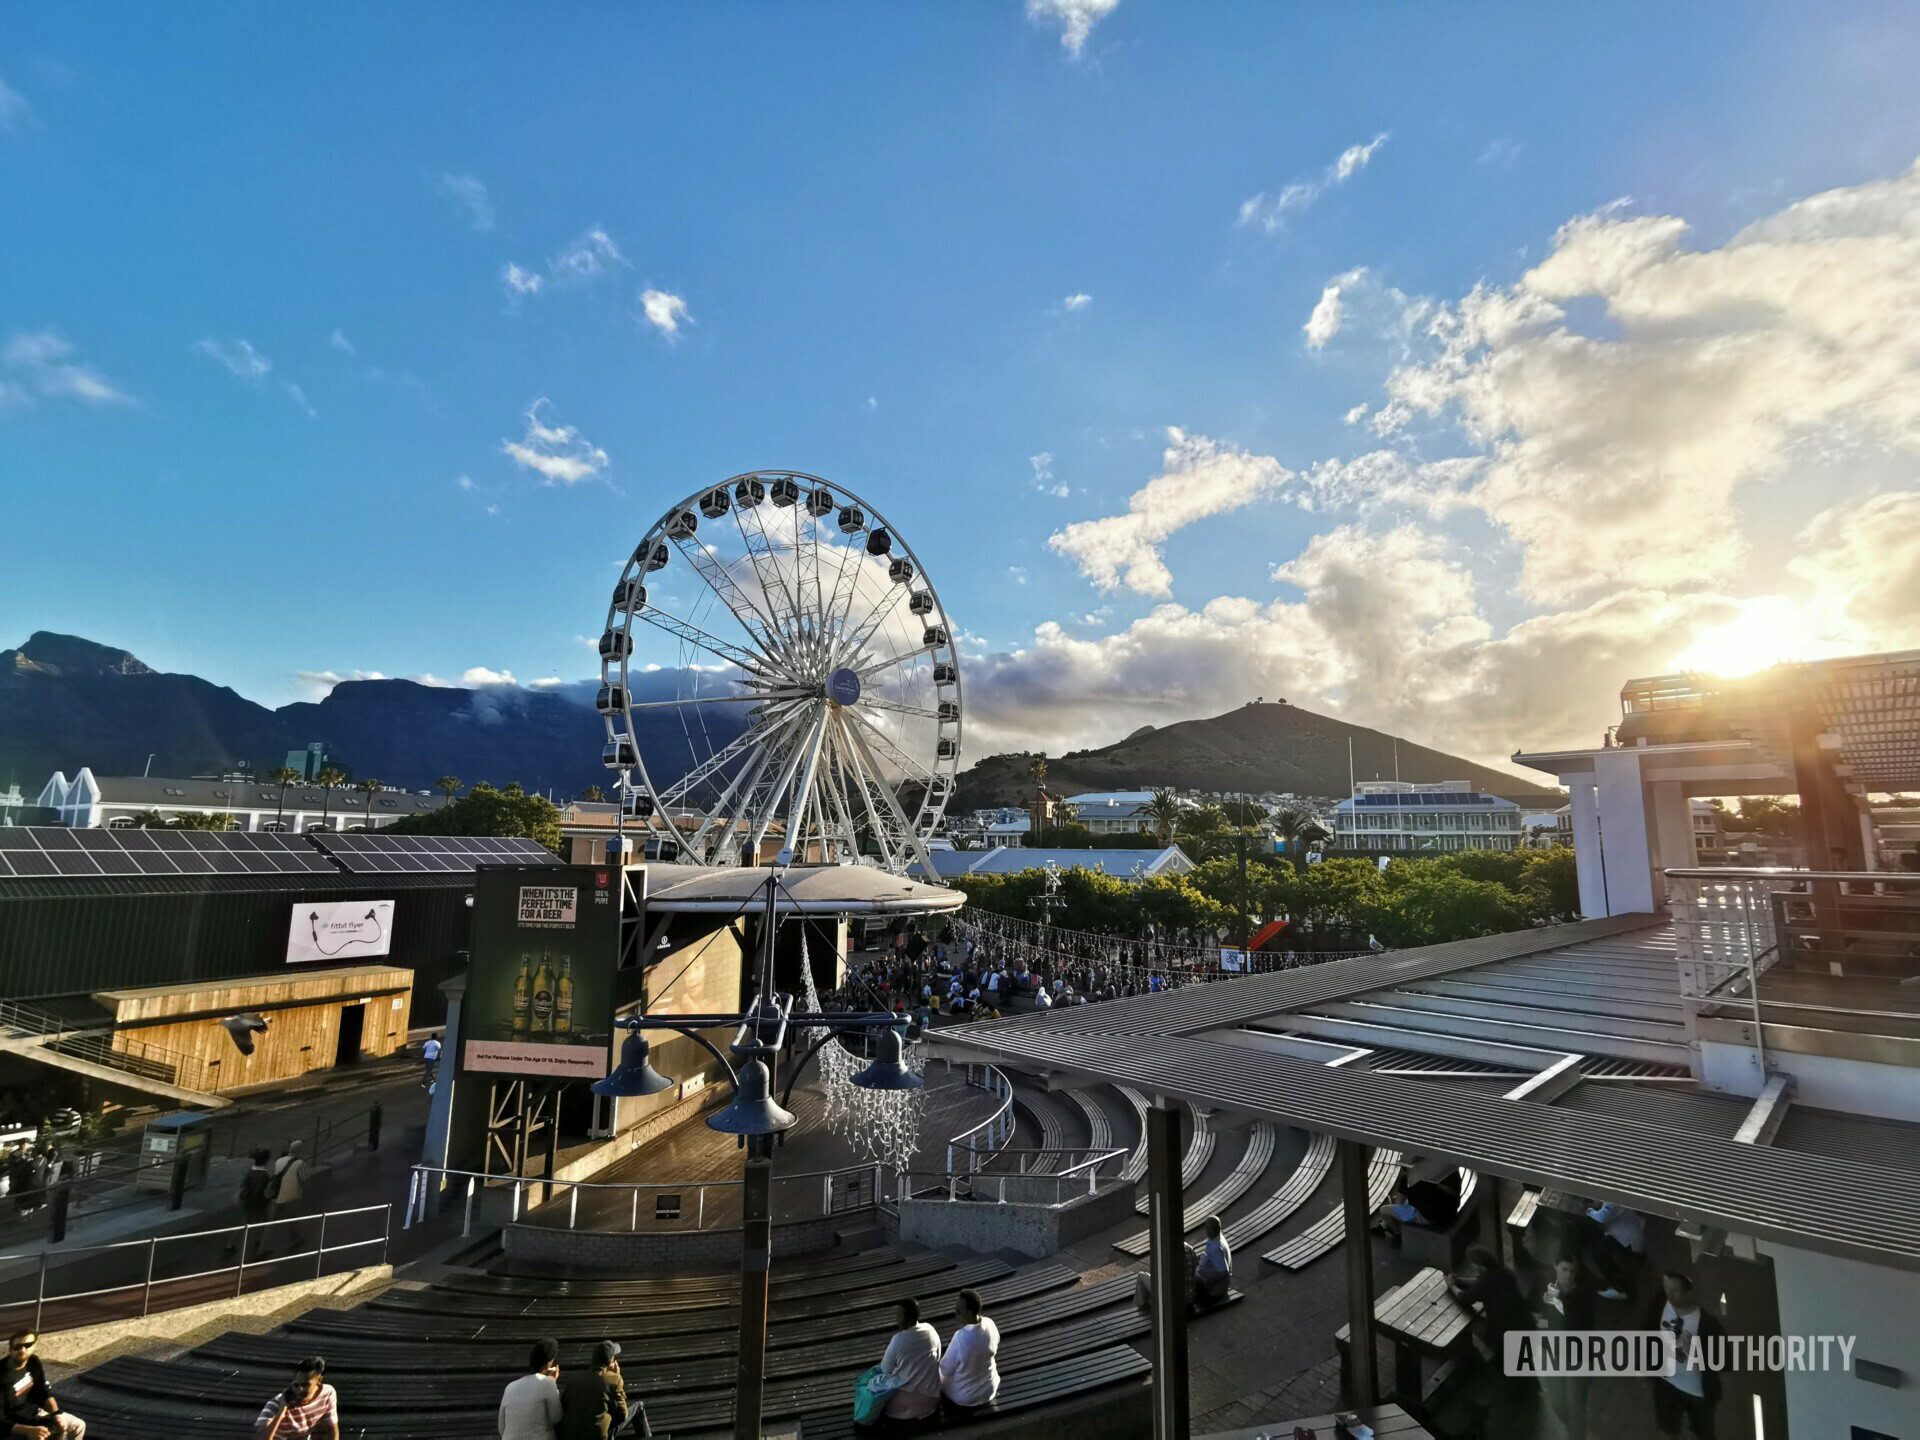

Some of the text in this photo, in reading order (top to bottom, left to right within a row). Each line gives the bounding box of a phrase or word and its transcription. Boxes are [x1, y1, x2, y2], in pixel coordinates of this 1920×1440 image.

[522, 888, 575, 899] WHEN IT'S THE
[521, 899, 573, 910] PERFECT TIME
[520, 909, 562, 920] FOR A BEER
[348, 921, 364, 929] flyer
